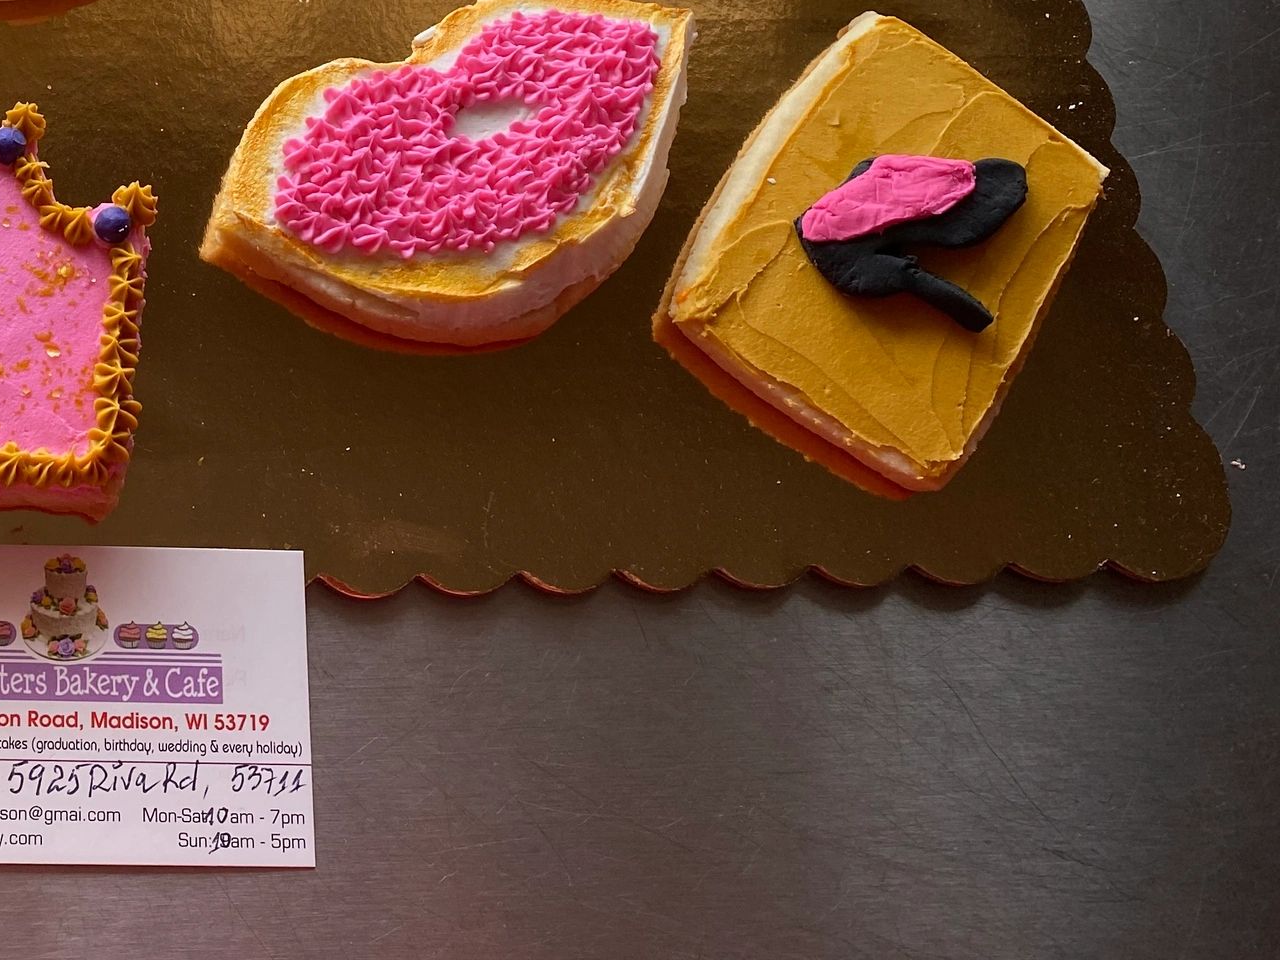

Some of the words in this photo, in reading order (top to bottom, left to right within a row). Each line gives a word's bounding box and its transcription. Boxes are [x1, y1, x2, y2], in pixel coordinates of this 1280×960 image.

[54, 666, 140, 702] Bakery
[143, 668, 160, 697] &
[165, 667, 220, 699] Cafe
[27, 710, 84, 730] Road,
[90, 711, 179, 732] Madison,
[185, 713, 208, 731] WI
[213, 714, 270, 731] 53719
[31, 736, 101, 754] (graduation,
[104, 738, 155, 755] birthday,
[158, 738, 207, 756] wedding
[210, 740, 220, 754] &
[222, 742, 253, 757] every
[256, 741, 304, 757] holiday)
[270, 809, 306, 828] 7pm
[271, 833, 306, 853] 5pm
